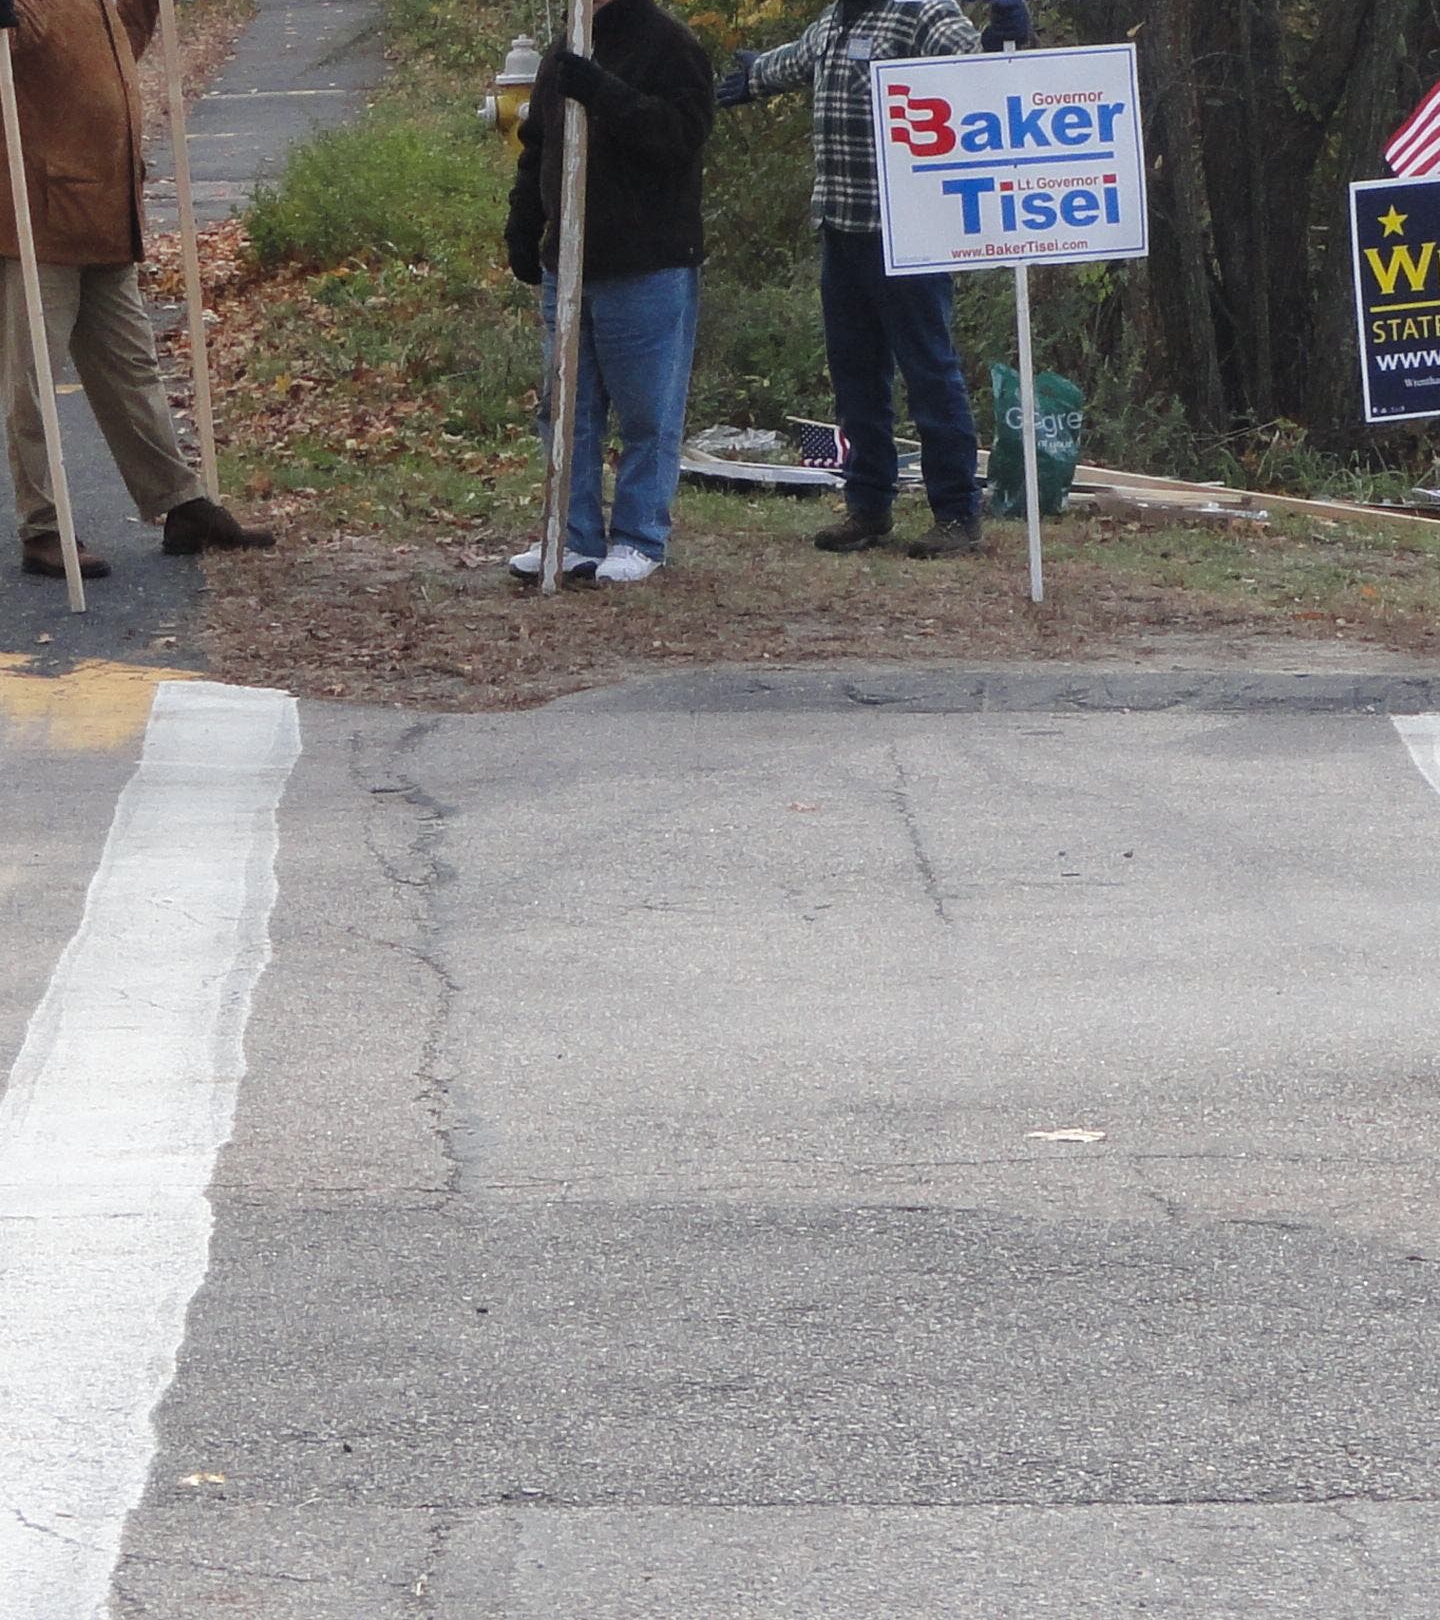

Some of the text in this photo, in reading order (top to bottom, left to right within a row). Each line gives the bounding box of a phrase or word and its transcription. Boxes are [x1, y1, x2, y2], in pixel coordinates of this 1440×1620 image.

[1032, 91, 1103, 106] Governor
[887, 84, 1125, 157] Baker
[1018, 175, 1099, 191] Lt. Governor
[942, 174, 1120, 235] Tisei
[951, 239, 1088, 259] www.BakerTisei.com
